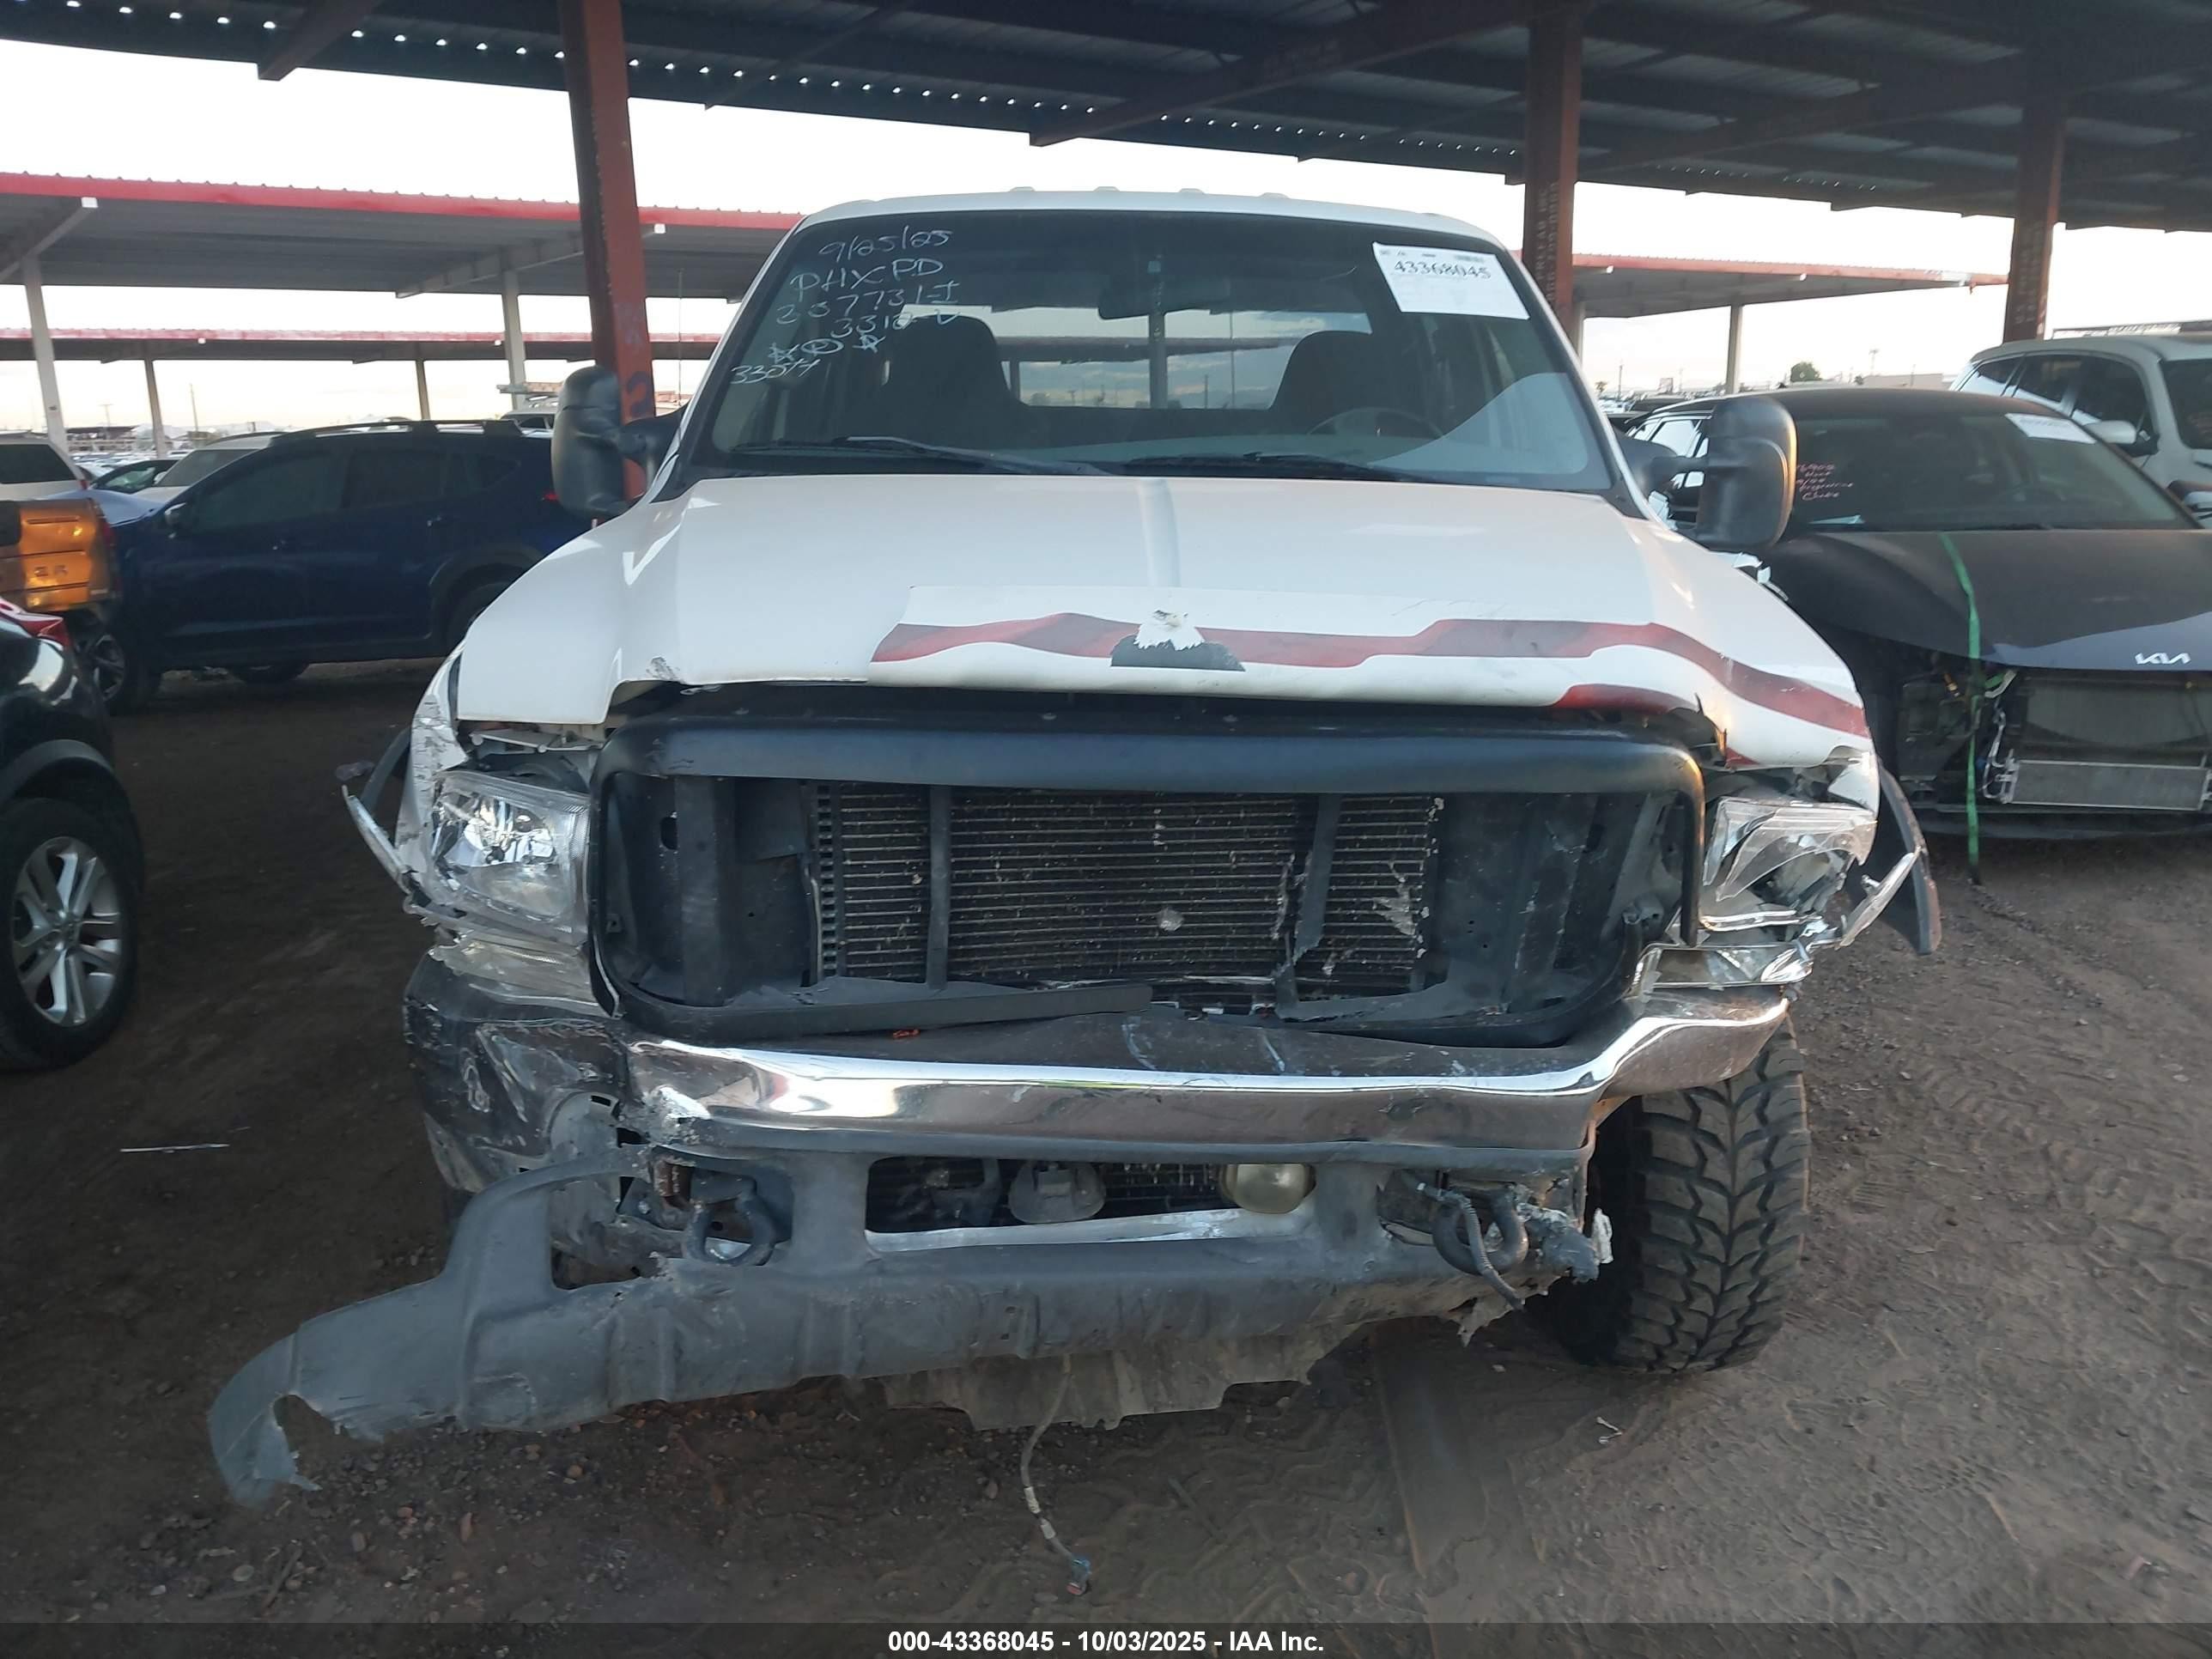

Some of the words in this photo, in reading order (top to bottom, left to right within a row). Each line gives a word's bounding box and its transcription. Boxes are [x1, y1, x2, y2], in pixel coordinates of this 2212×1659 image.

[818, 225, 953, 263] 9/25/25
[790, 265, 886, 302] PHX
[1394, 260, 1492, 279] 43368045
[2135, 652, 2191, 665] KIA
